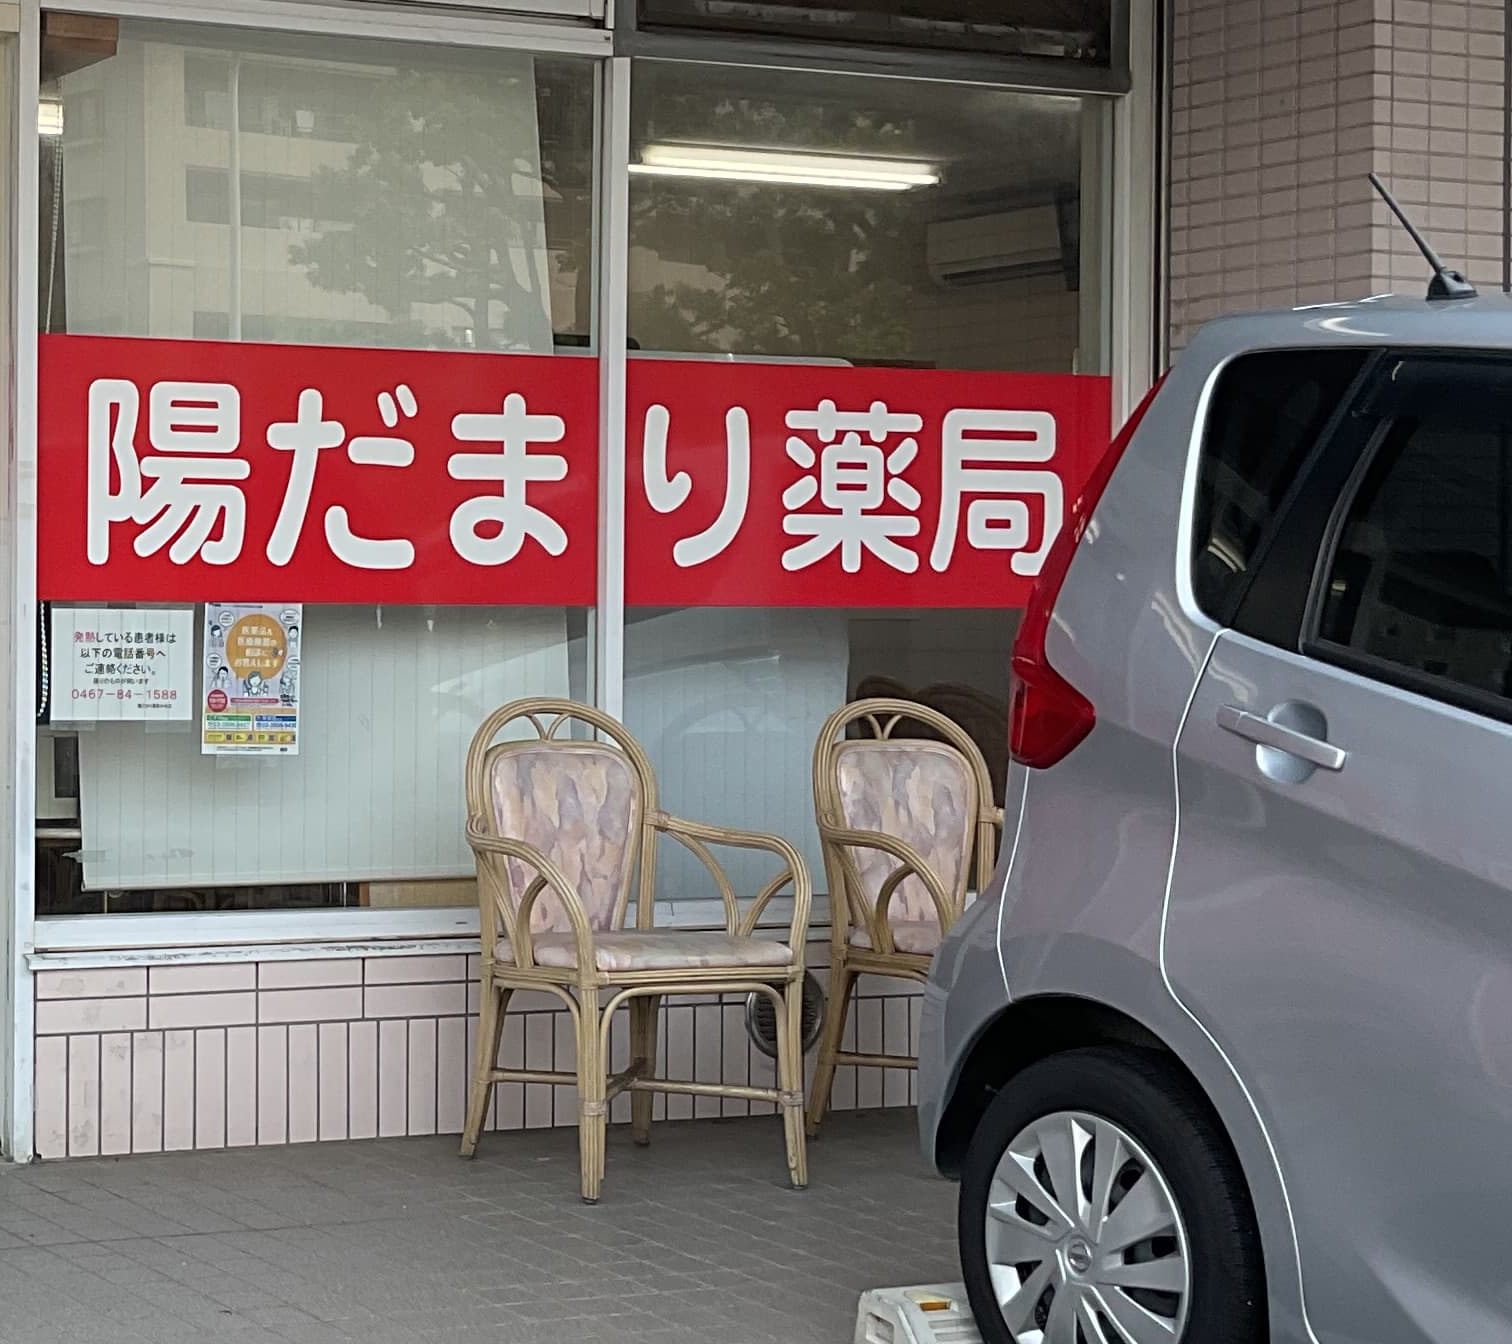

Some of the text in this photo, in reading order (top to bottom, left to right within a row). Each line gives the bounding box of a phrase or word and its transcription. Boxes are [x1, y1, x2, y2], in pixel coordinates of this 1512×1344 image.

[85, 378, 1064, 577] 陽だまり薬局
[73, 631, 177, 644] 発熱している患者様は
[80, 647, 167, 659] 以下の電話番号へ
[84, 663, 156, 676] ご連絡ください。
